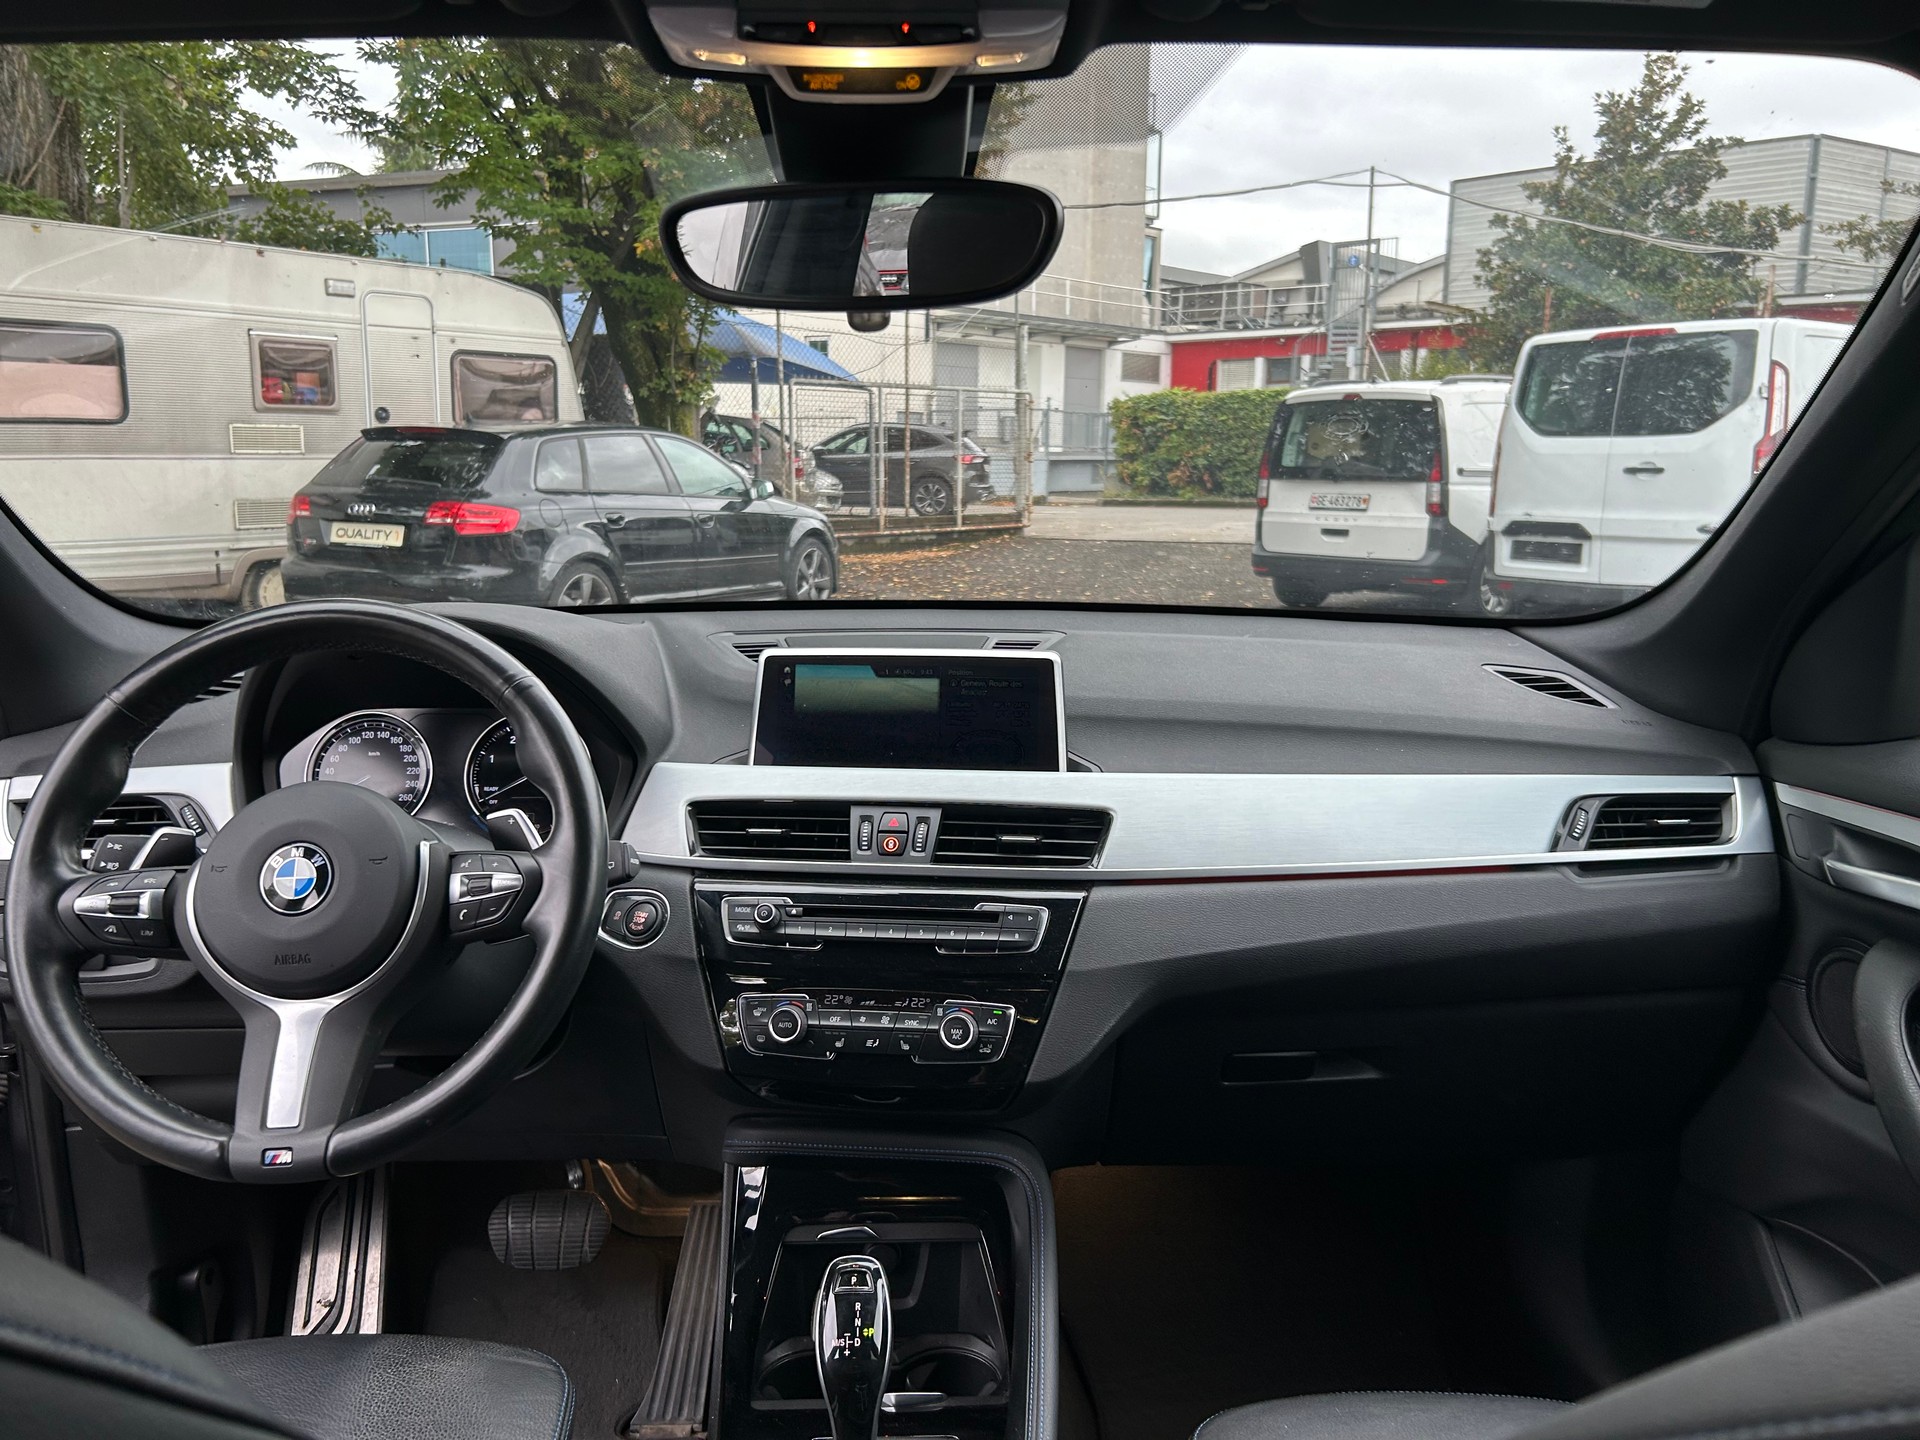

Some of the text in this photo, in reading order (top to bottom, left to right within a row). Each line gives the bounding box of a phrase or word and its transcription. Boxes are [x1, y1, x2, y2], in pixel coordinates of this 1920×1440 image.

[362, 731, 374, 739] 120
[377, 731, 390, 739] 140
[390, 736, 402, 744] 160
[510, 735, 517, 744] 2
[489, 754, 494, 763] 1
[270, 847, 325, 868] BMW
[274, 954, 311, 965] AIRBAG
[851, 1276, 857, 1285] P
[855, 1302, 861, 1310] R
[855, 1318, 861, 1326] N
[869, 1328, 875, 1337] P
[855, 1338, 861, 1346] D
